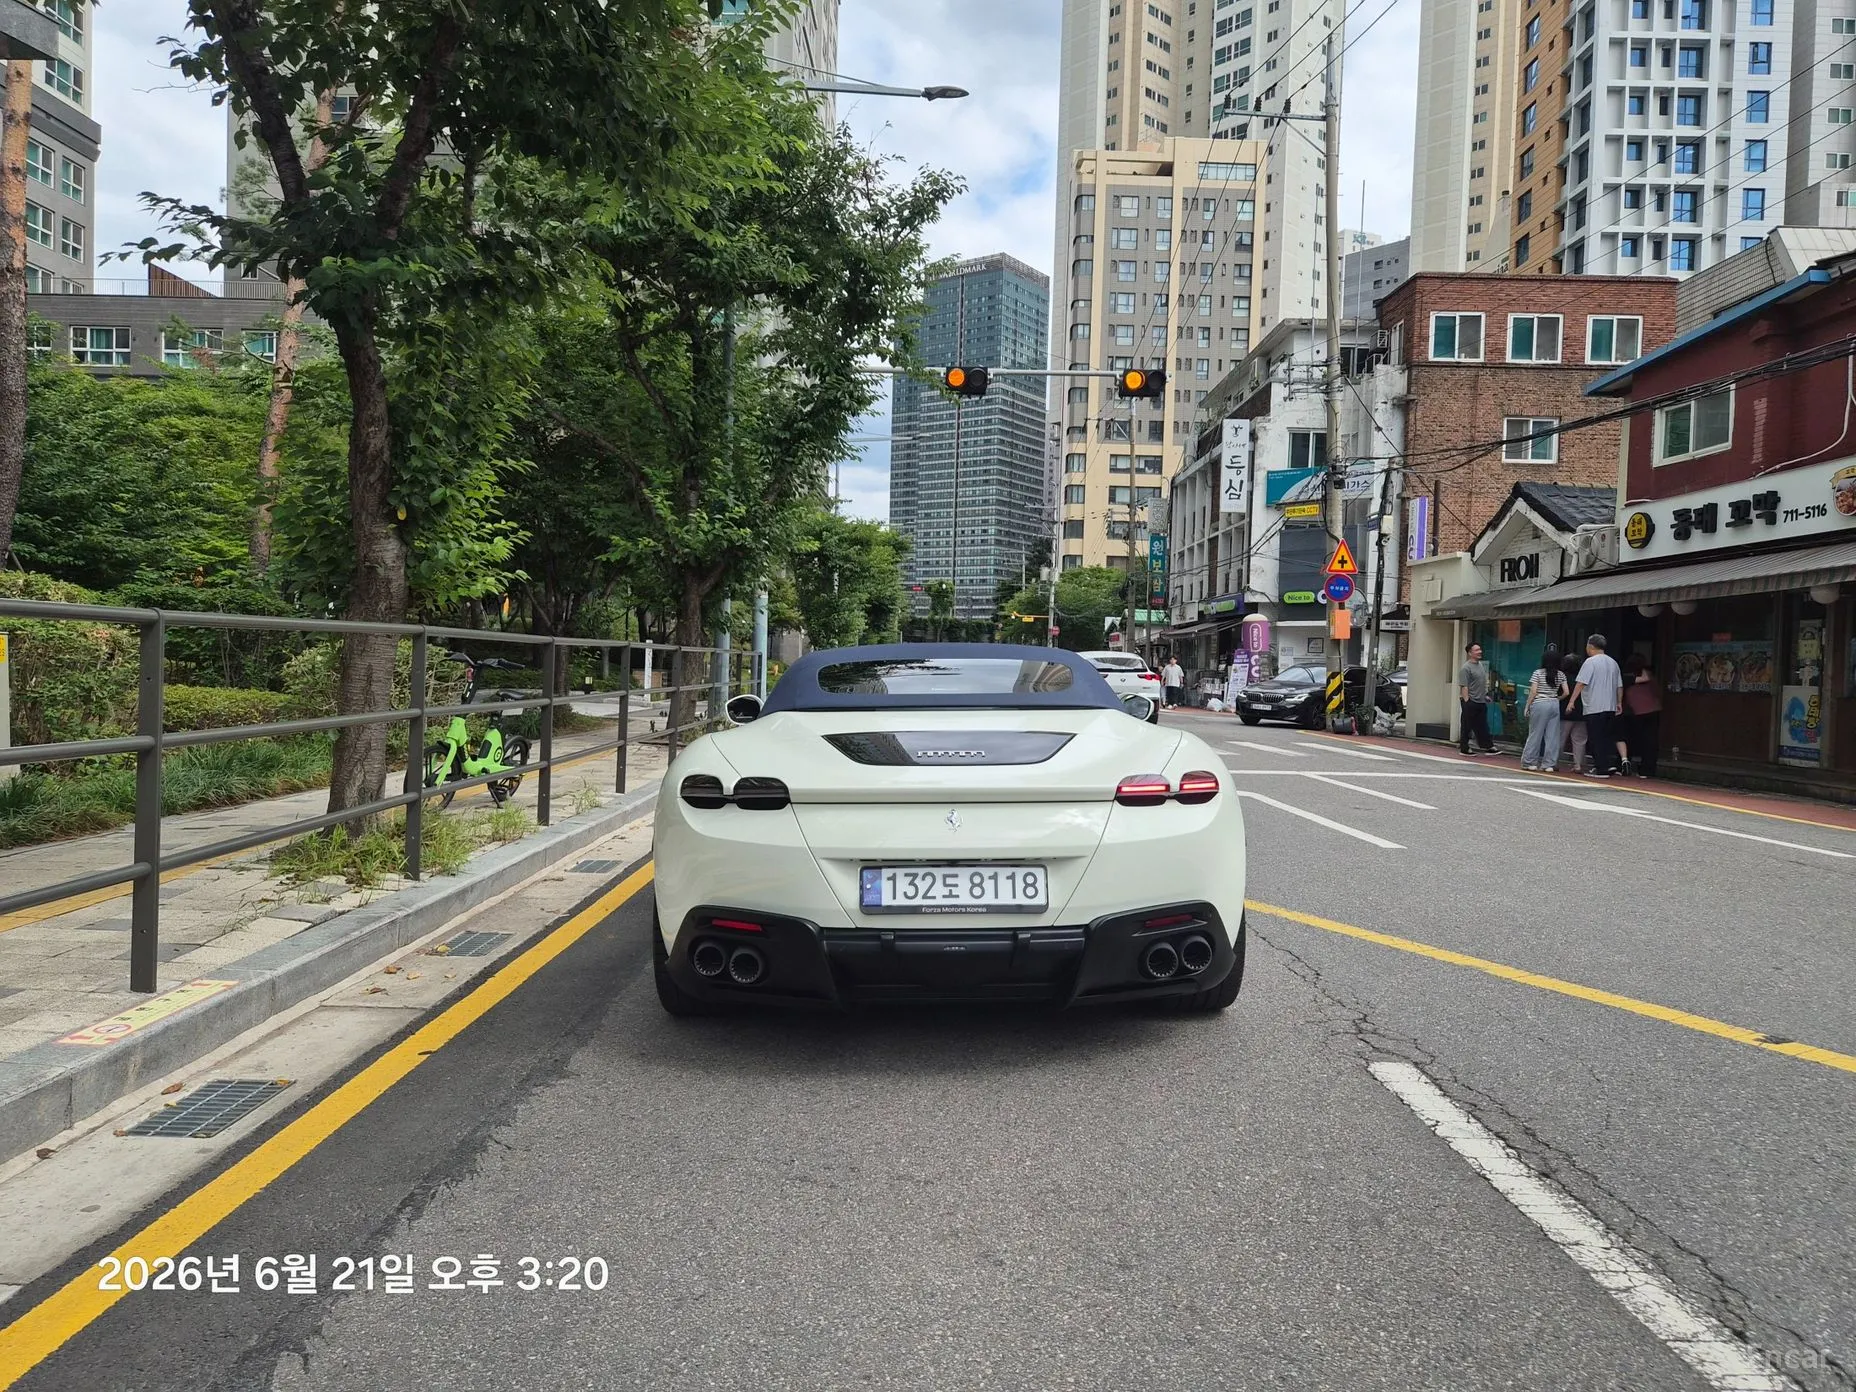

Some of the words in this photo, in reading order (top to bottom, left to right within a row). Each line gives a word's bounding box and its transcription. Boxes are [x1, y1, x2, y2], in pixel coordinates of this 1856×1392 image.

[1225, 455, 1246, 500] 등심
[1670, 502, 1718, 541] 동태
[1725, 490, 1781, 528] 꼬막
[1783, 503, 1827, 524] 711-5116
[886, 871, 960, 900] 132도
[969, 871, 1039, 900] 8118
